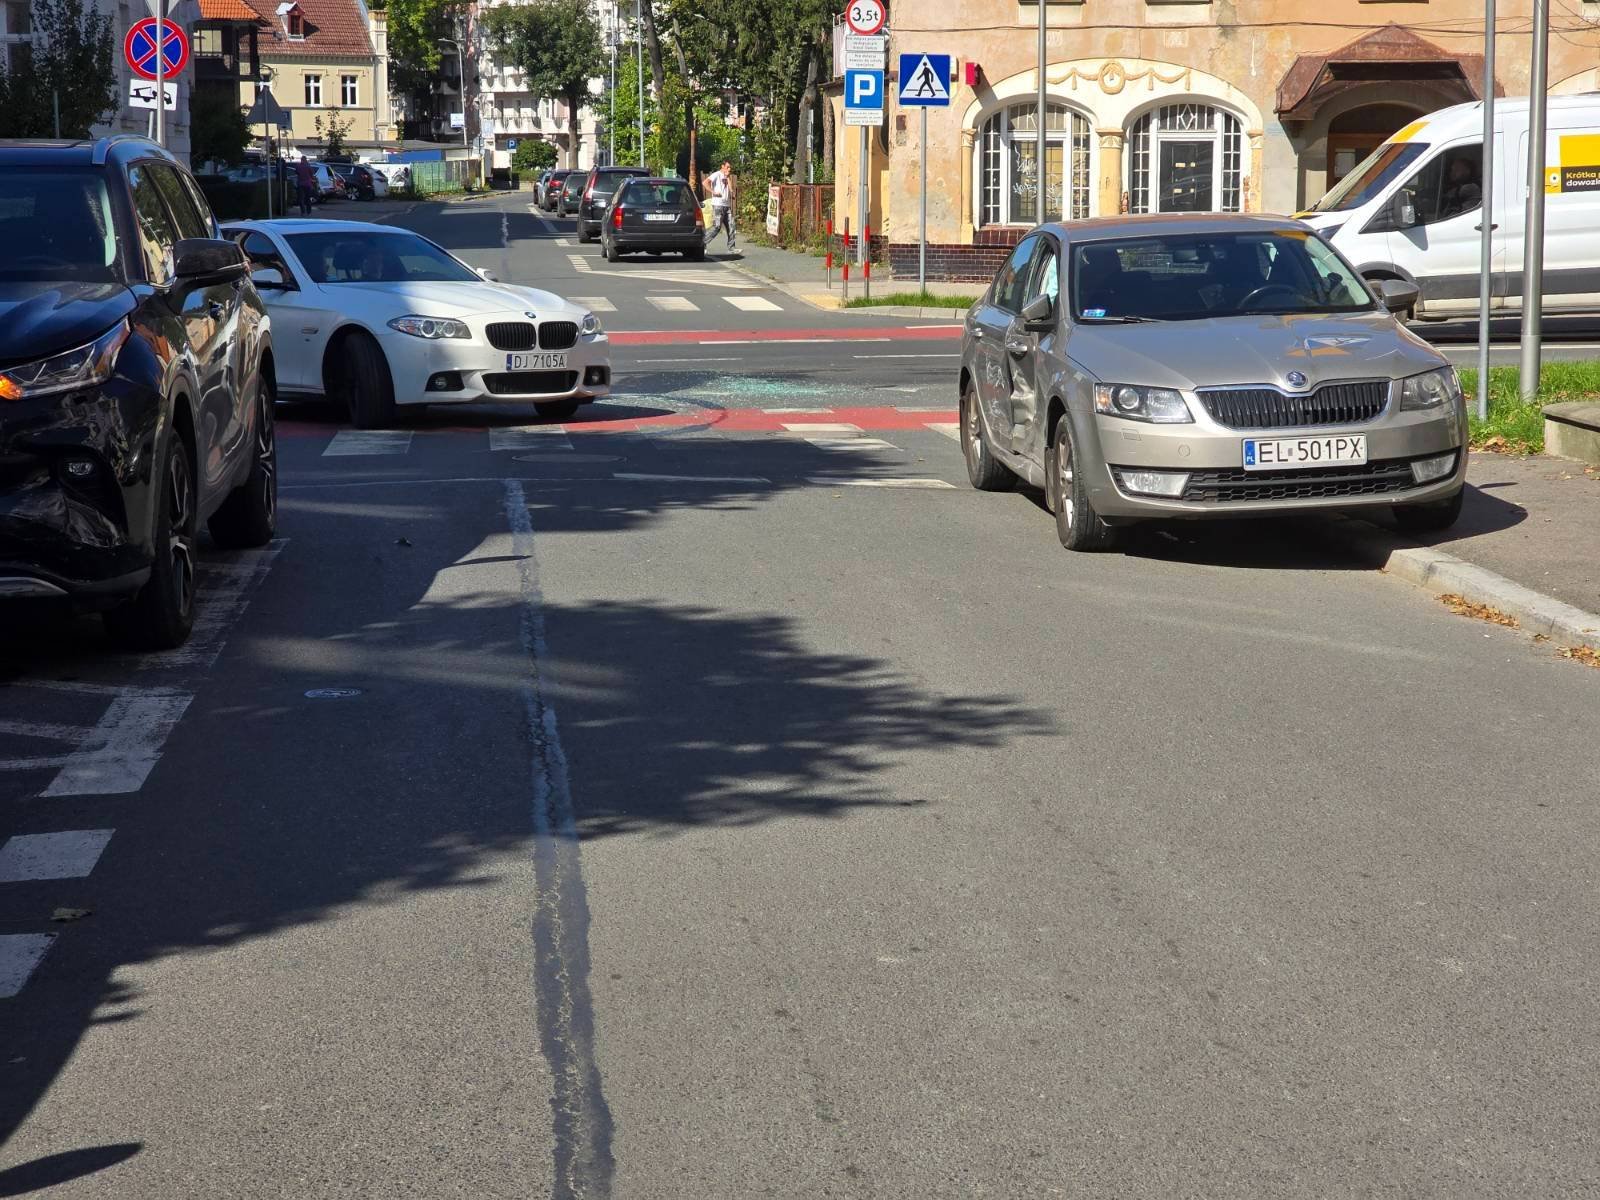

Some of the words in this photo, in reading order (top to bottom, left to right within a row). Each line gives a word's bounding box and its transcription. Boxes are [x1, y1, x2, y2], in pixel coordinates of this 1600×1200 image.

[852, 7, 879, 22] 3,5t
[854, 74, 875, 104] P
[509, 140, 515, 149] P
[1566, 171, 1596, 179] Krótka
[514, 355, 528, 368] DJ
[533, 354, 565, 368] 7105A
[1259, 442, 1288, 463] EL
[1298, 438, 1361, 461] 501PX
